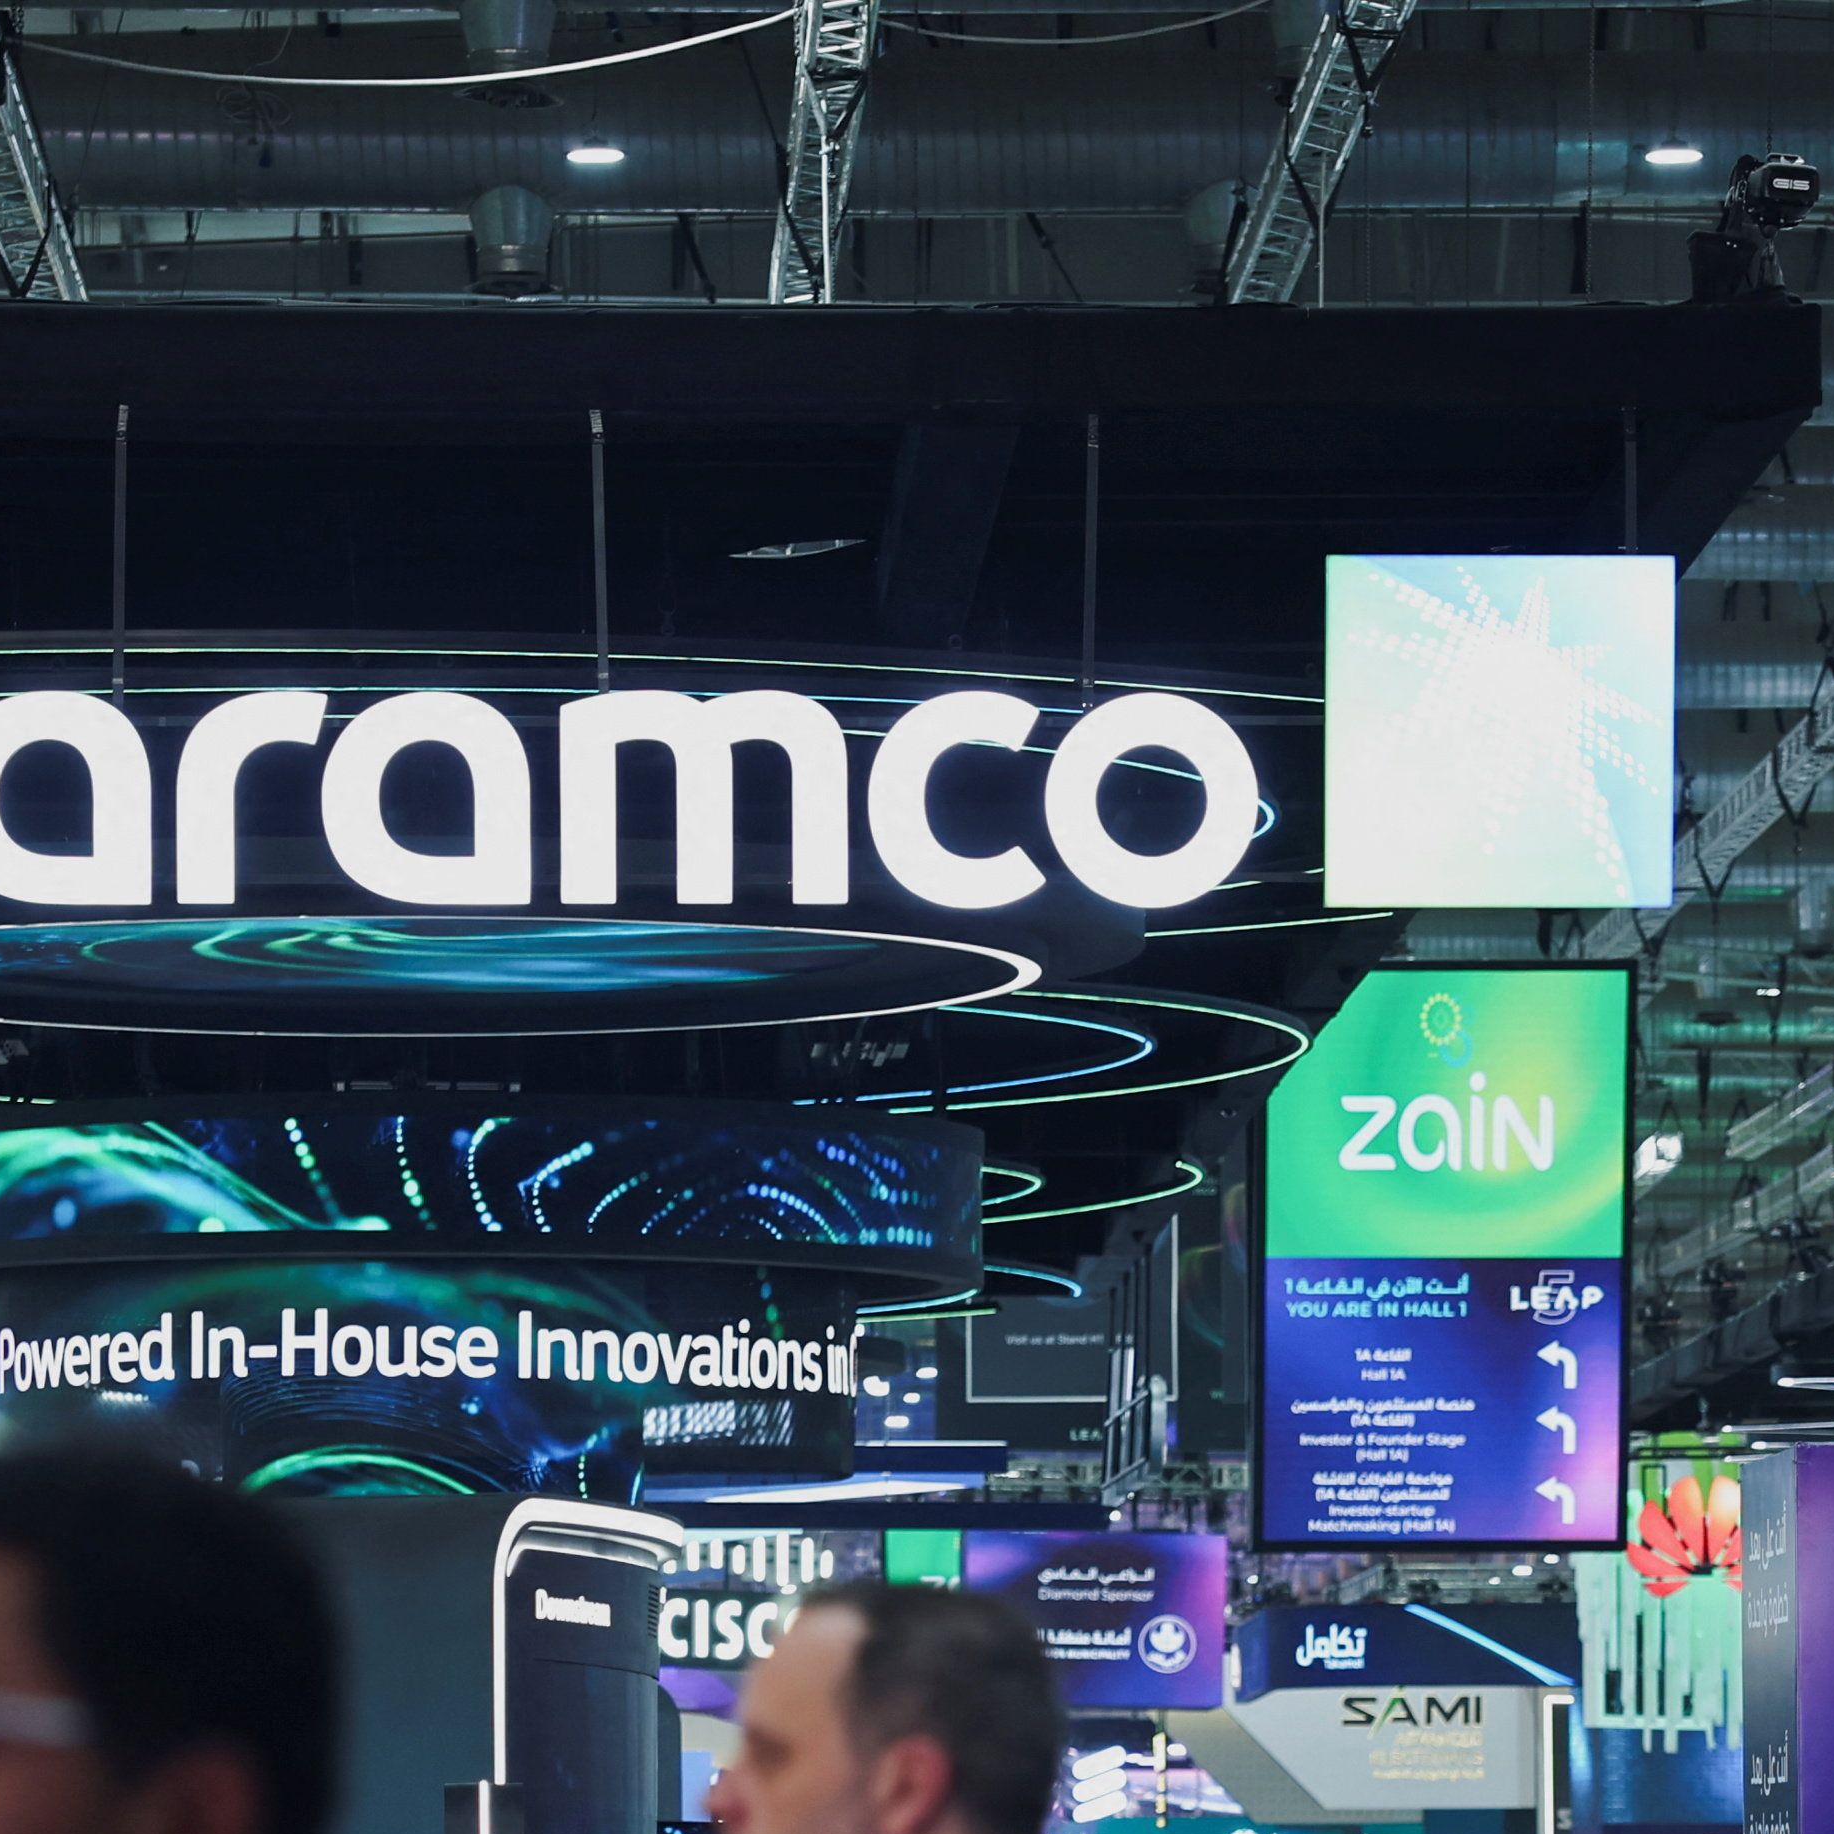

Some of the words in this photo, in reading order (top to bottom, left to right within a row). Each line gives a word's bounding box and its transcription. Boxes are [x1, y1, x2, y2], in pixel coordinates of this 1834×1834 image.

[1286, 1301, 1328, 1318] YOU
[1332, 1301, 1372, 1318] ARE
[1378, 1301, 1399, 1317] IN
[1404, 1301, 1454, 1318] HALL
[1458, 1301, 1467, 1317] 1
[1510, 1285, 1604, 1311] LEAP
[191, 1307, 499, 1379] In-House
[518, 1310, 823, 1394] Innovations
[826, 1325, 849, 1396] in
[1296, 1623, 1367, 1667] تكامل
[1341, 1687, 1483, 1735] SAMI
